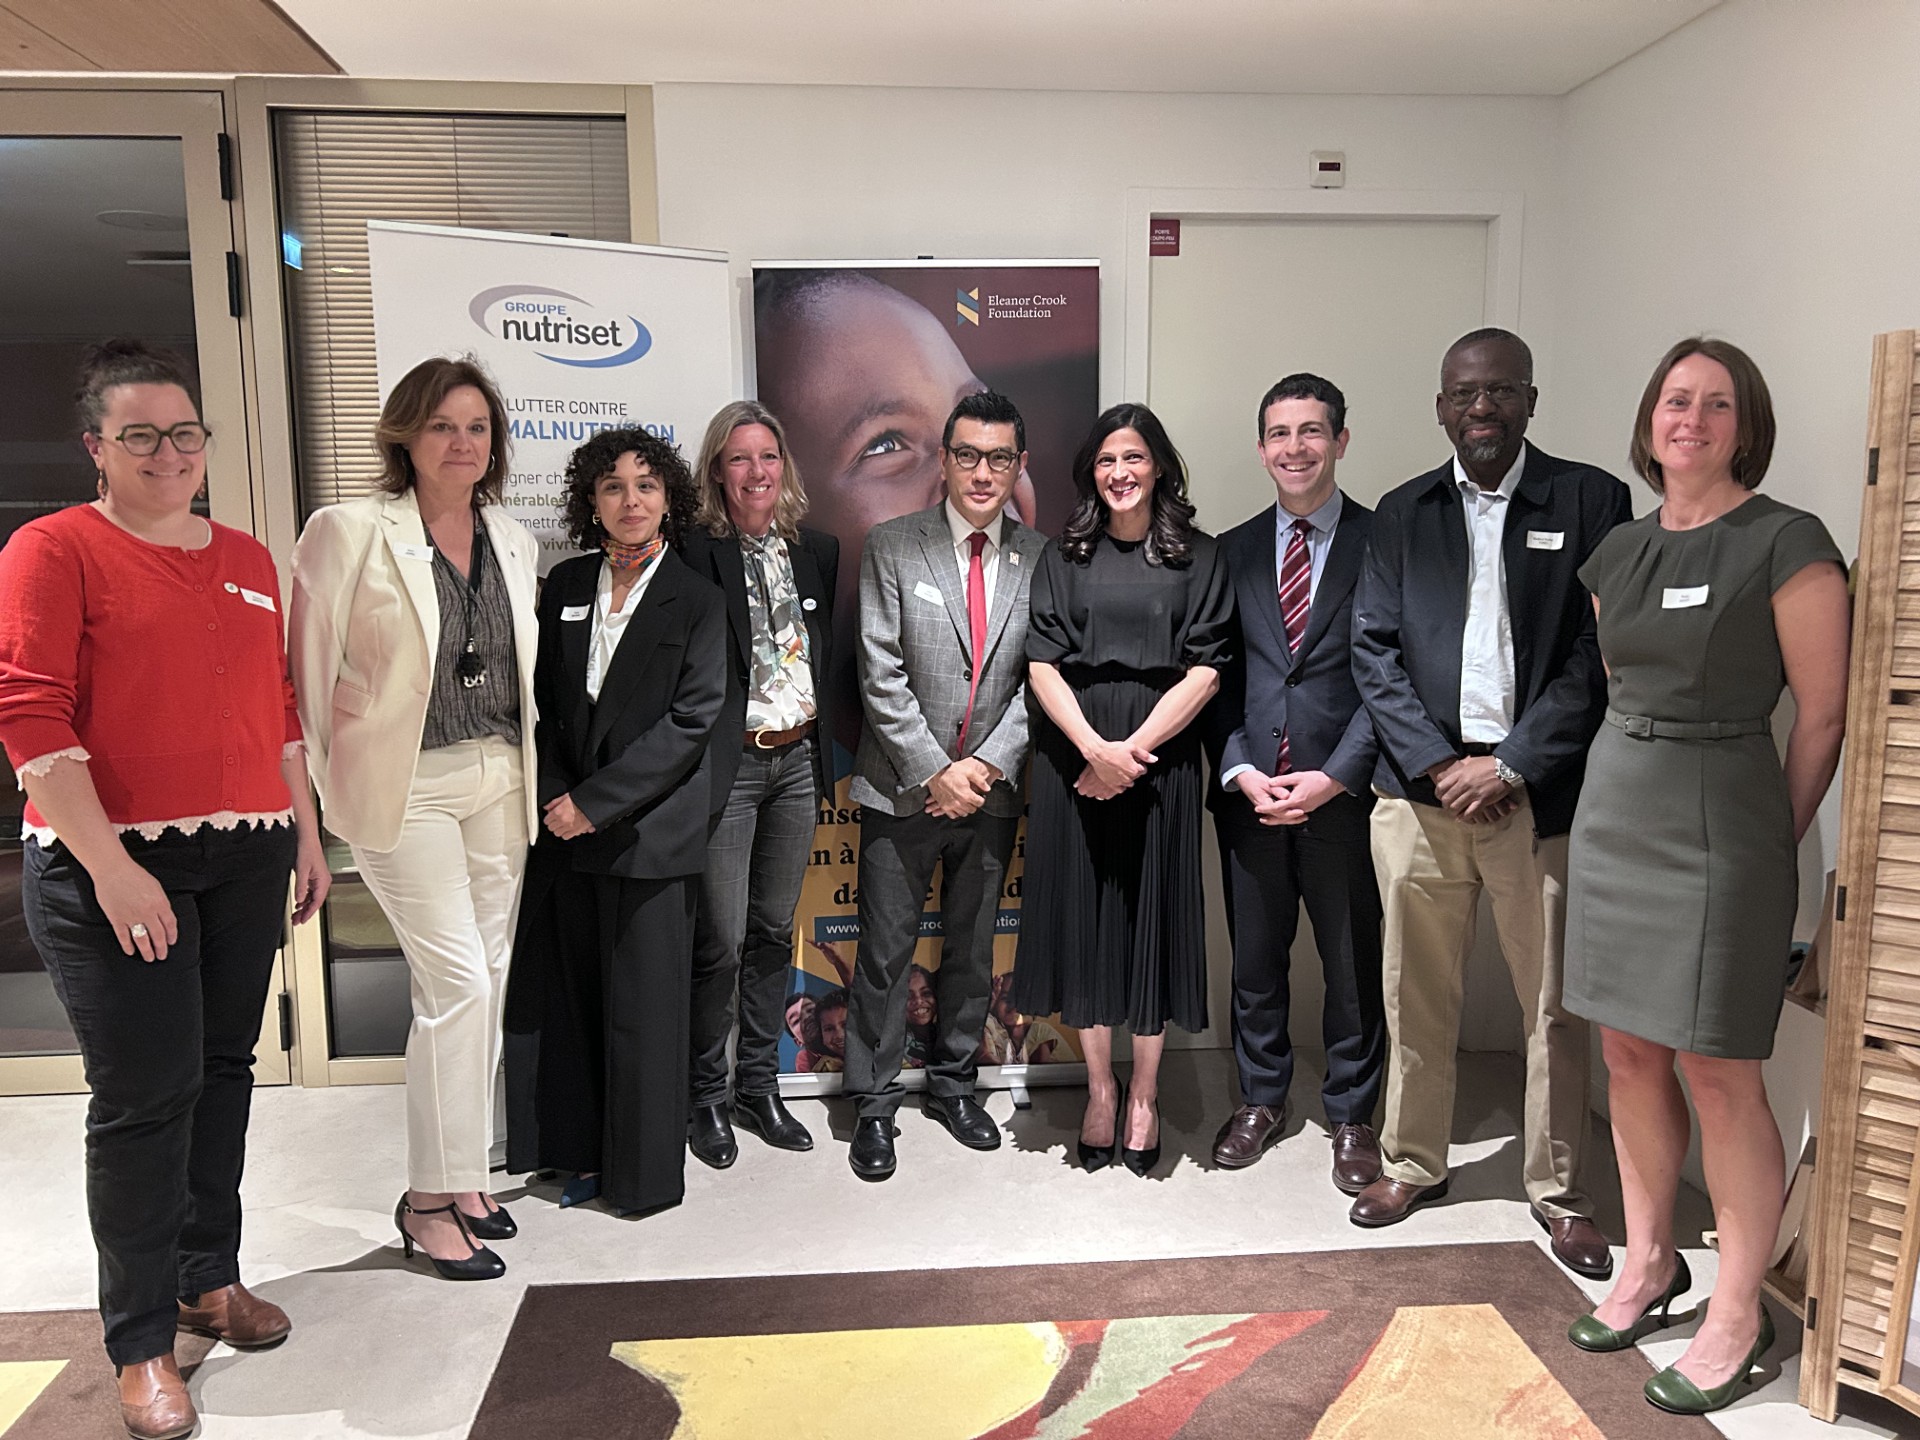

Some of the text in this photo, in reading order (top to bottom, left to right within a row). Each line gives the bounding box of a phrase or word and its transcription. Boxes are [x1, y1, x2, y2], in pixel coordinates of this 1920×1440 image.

[988, 294, 1067, 306] Eleanor Crook
[505, 302, 567, 316] GROUPE
[988, 307, 1052, 319] Foundation
[502, 315, 623, 347] nutriset
[506, 398, 628, 416] LUTTER CONTRE
